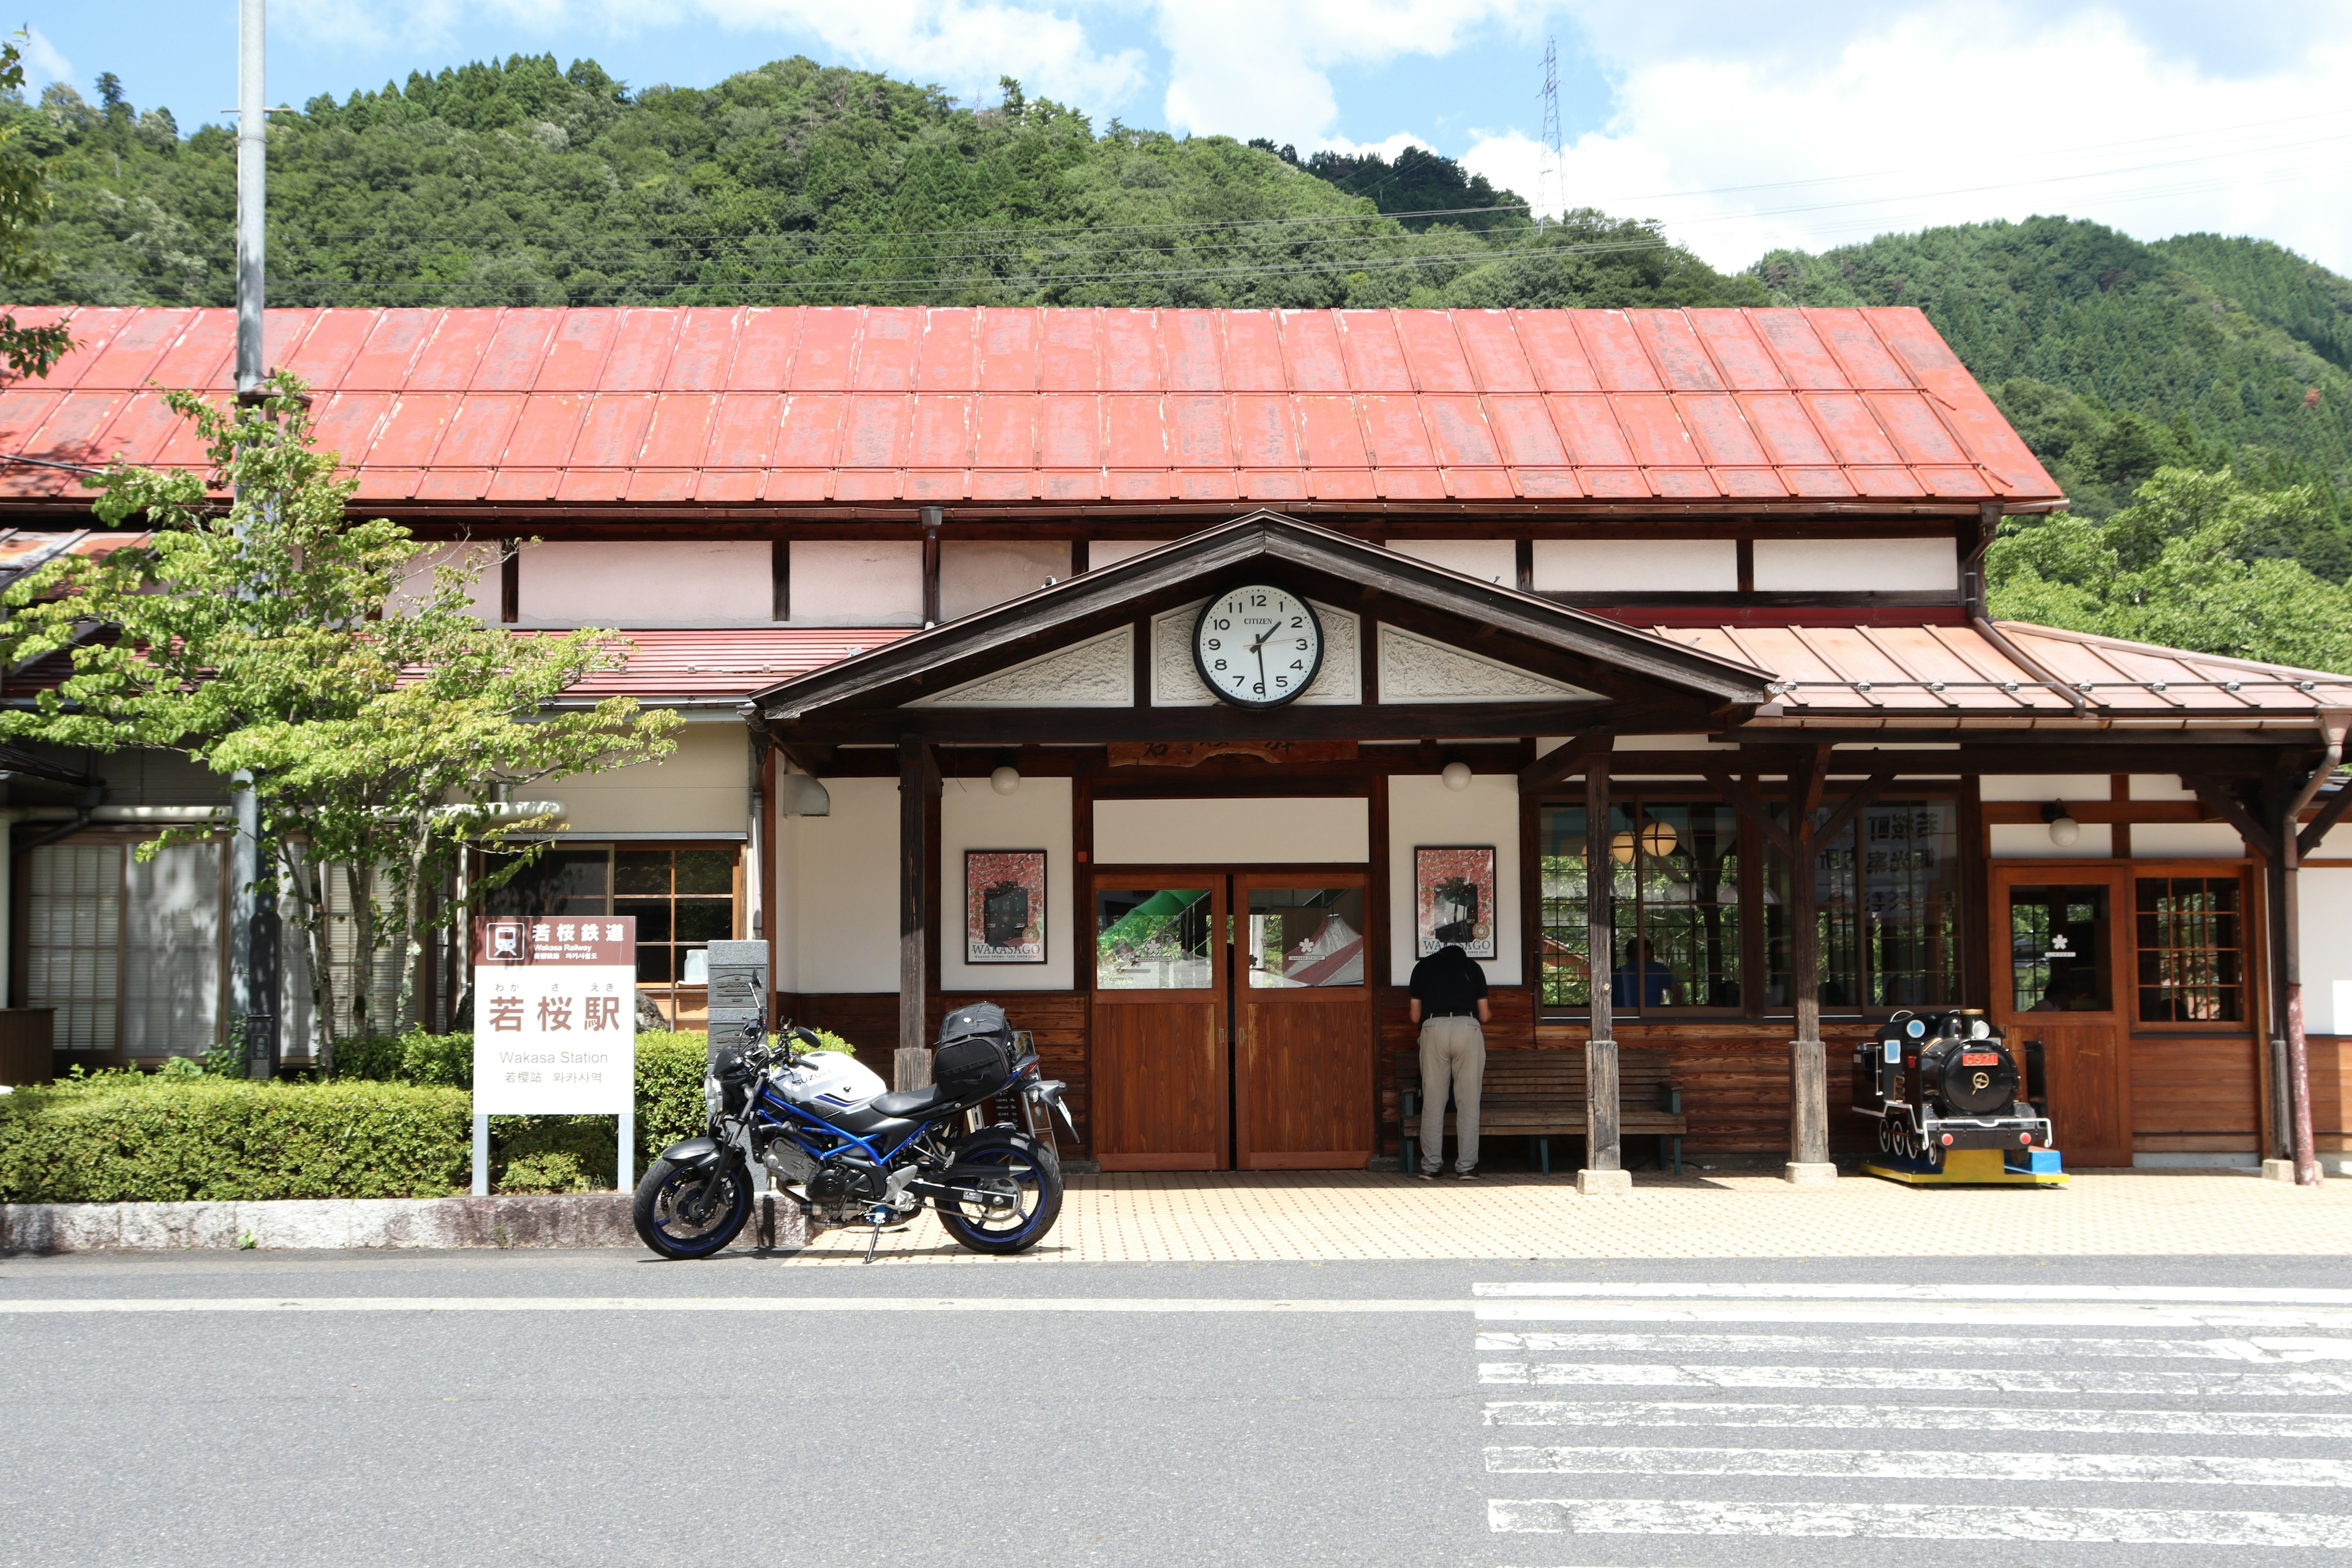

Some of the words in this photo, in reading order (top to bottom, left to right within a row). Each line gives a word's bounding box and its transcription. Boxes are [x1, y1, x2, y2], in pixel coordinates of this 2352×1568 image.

[1250, 595, 1267, 606] 12
[1228, 601, 1243, 613] 11
[1279, 601, 1284, 612] 1
[1213, 619, 1230, 630] 10
[1291, 616, 1303, 628] 2
[1208, 639, 1221, 650] 9
[1295, 639, 1308, 650] 3
[1215, 659, 1227, 670] 8
[1289, 659, 1303, 670] 4
[1232, 676, 1245, 687] 7
[1275, 676, 1287, 687] 5
[1253, 682, 1265, 694] 6
[532, 923, 624, 942] 若桜鉄道
[564, 944, 592, 952] Railway
[972, 944, 1040, 954] WAKASAGO
[488, 996, 620, 1032] 若桜駅
[500, 1052, 555, 1064] Wakasa
[560, 1051, 608, 1063] Station
[553, 1071, 601, 1084] 와카사역
